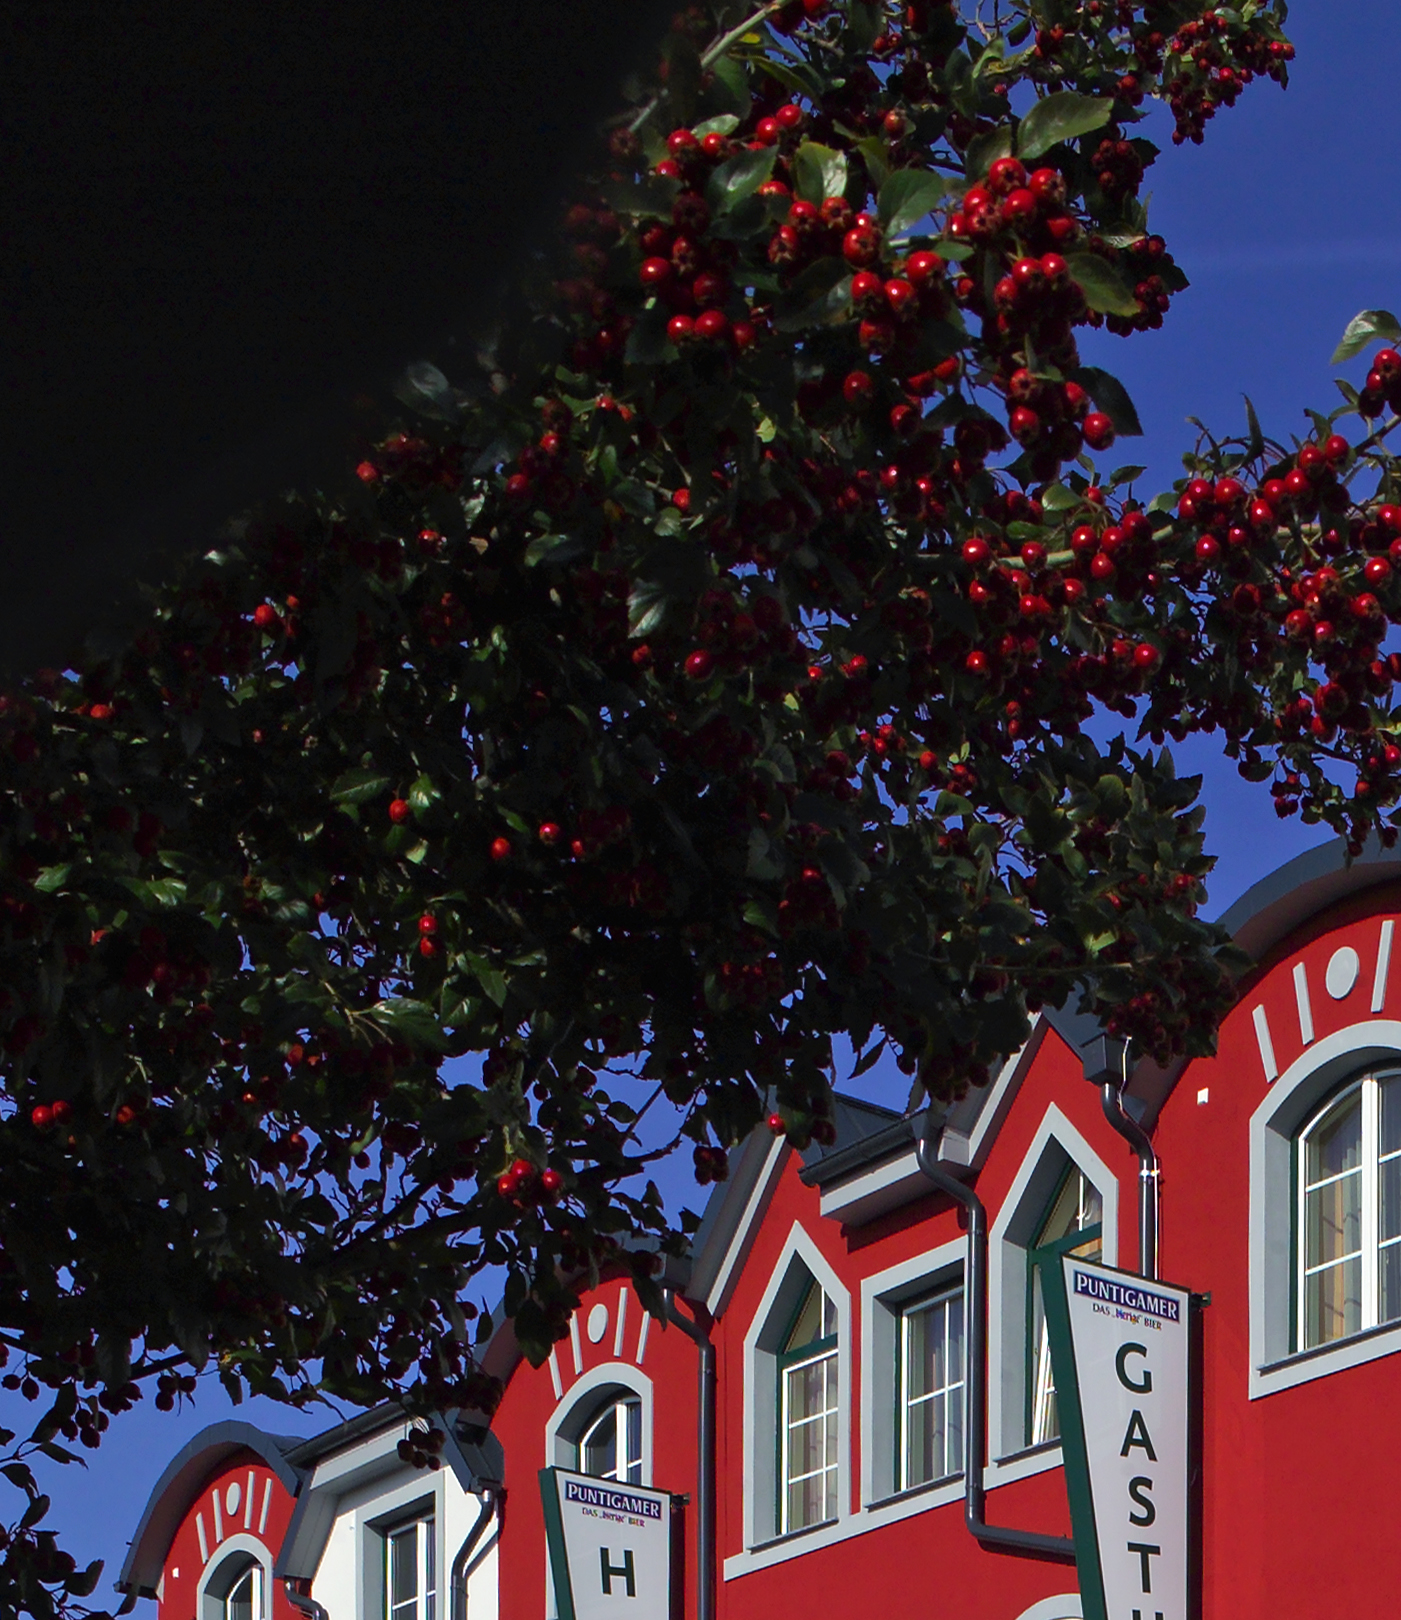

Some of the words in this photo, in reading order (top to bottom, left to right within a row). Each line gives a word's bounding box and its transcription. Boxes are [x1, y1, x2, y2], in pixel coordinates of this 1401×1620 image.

[1076, 1273, 1178, 1319] PUNTIGAMER
[1092, 1302, 1111, 1317] DAS
[1144, 1316, 1162, 1331] BIER
[567, 1483, 660, 1517] PUNTIGAMER
